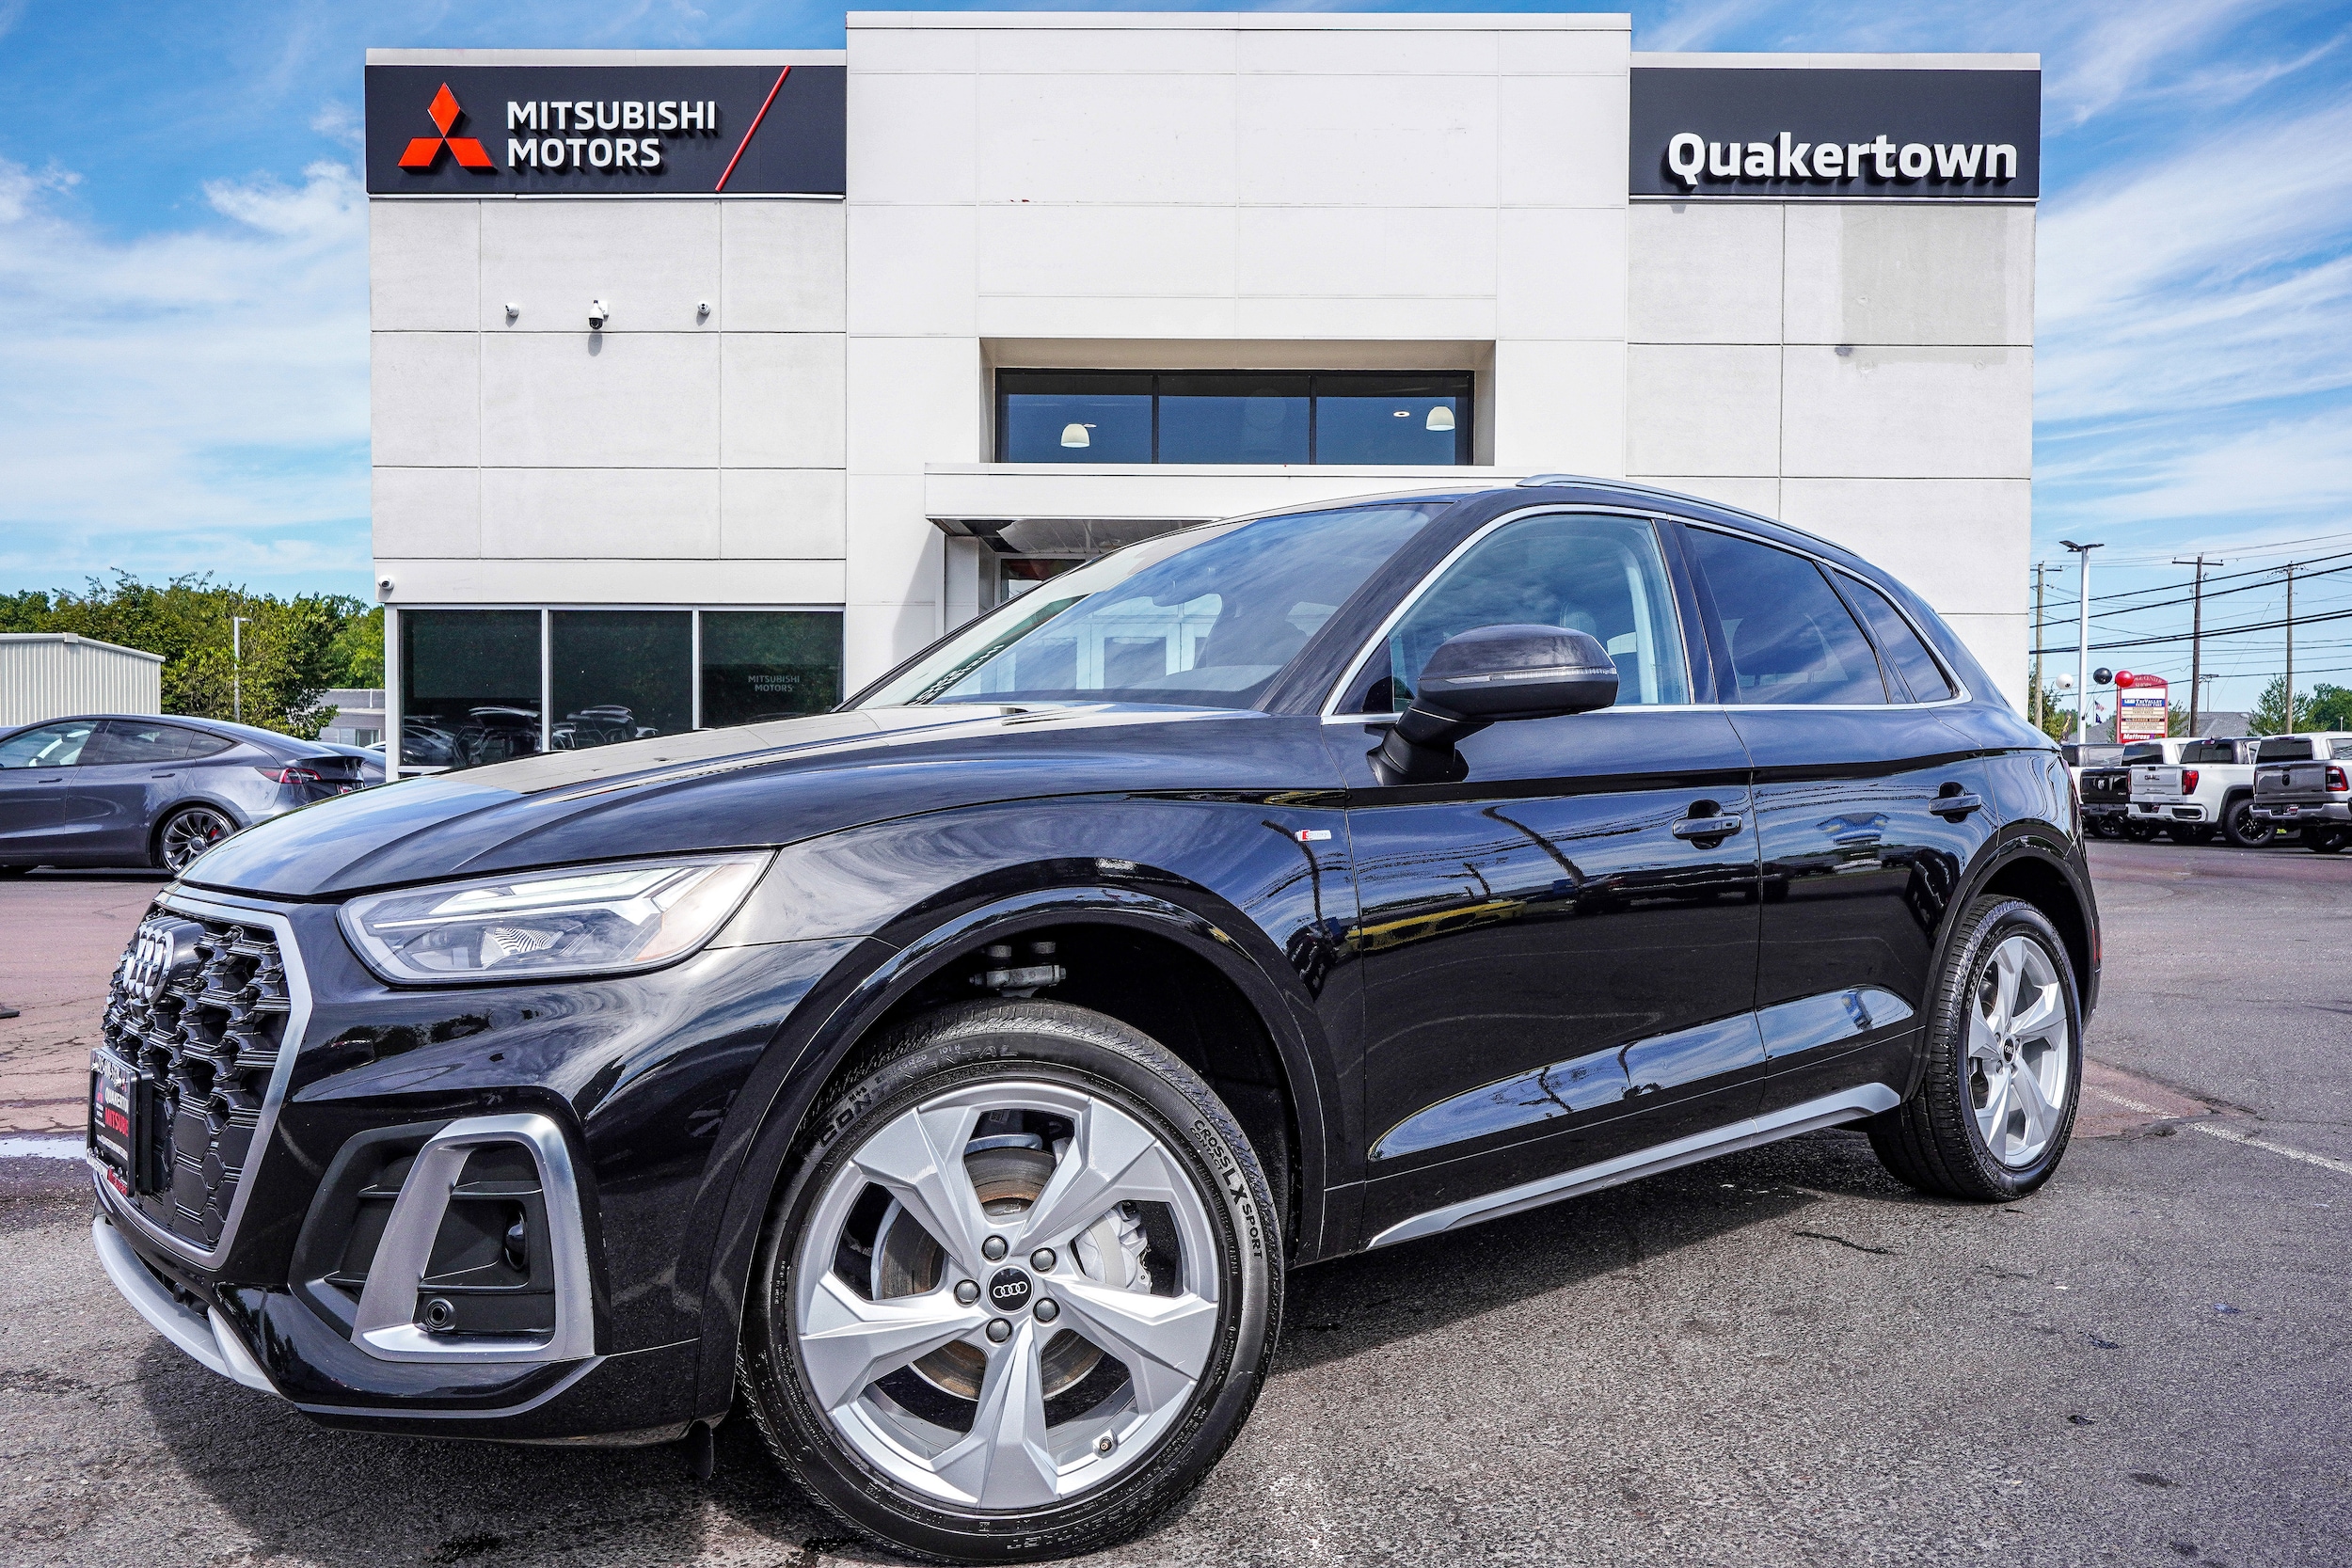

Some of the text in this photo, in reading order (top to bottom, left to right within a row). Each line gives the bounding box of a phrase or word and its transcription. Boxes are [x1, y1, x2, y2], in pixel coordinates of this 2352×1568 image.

[507, 101, 716, 131] MITSUBISHI
[508, 138, 660, 167] MOTORS
[1668, 132, 2017, 185] Quakertown
[755, 684, 793, 692] MOTORS
[1189, 1127, 1224, 1170] CONTACT
[1194, 1119, 1232, 1168] CROSS
[1221, 1167, 1248, 1205] LX
[1241, 1203, 1263, 1259] SPORT
